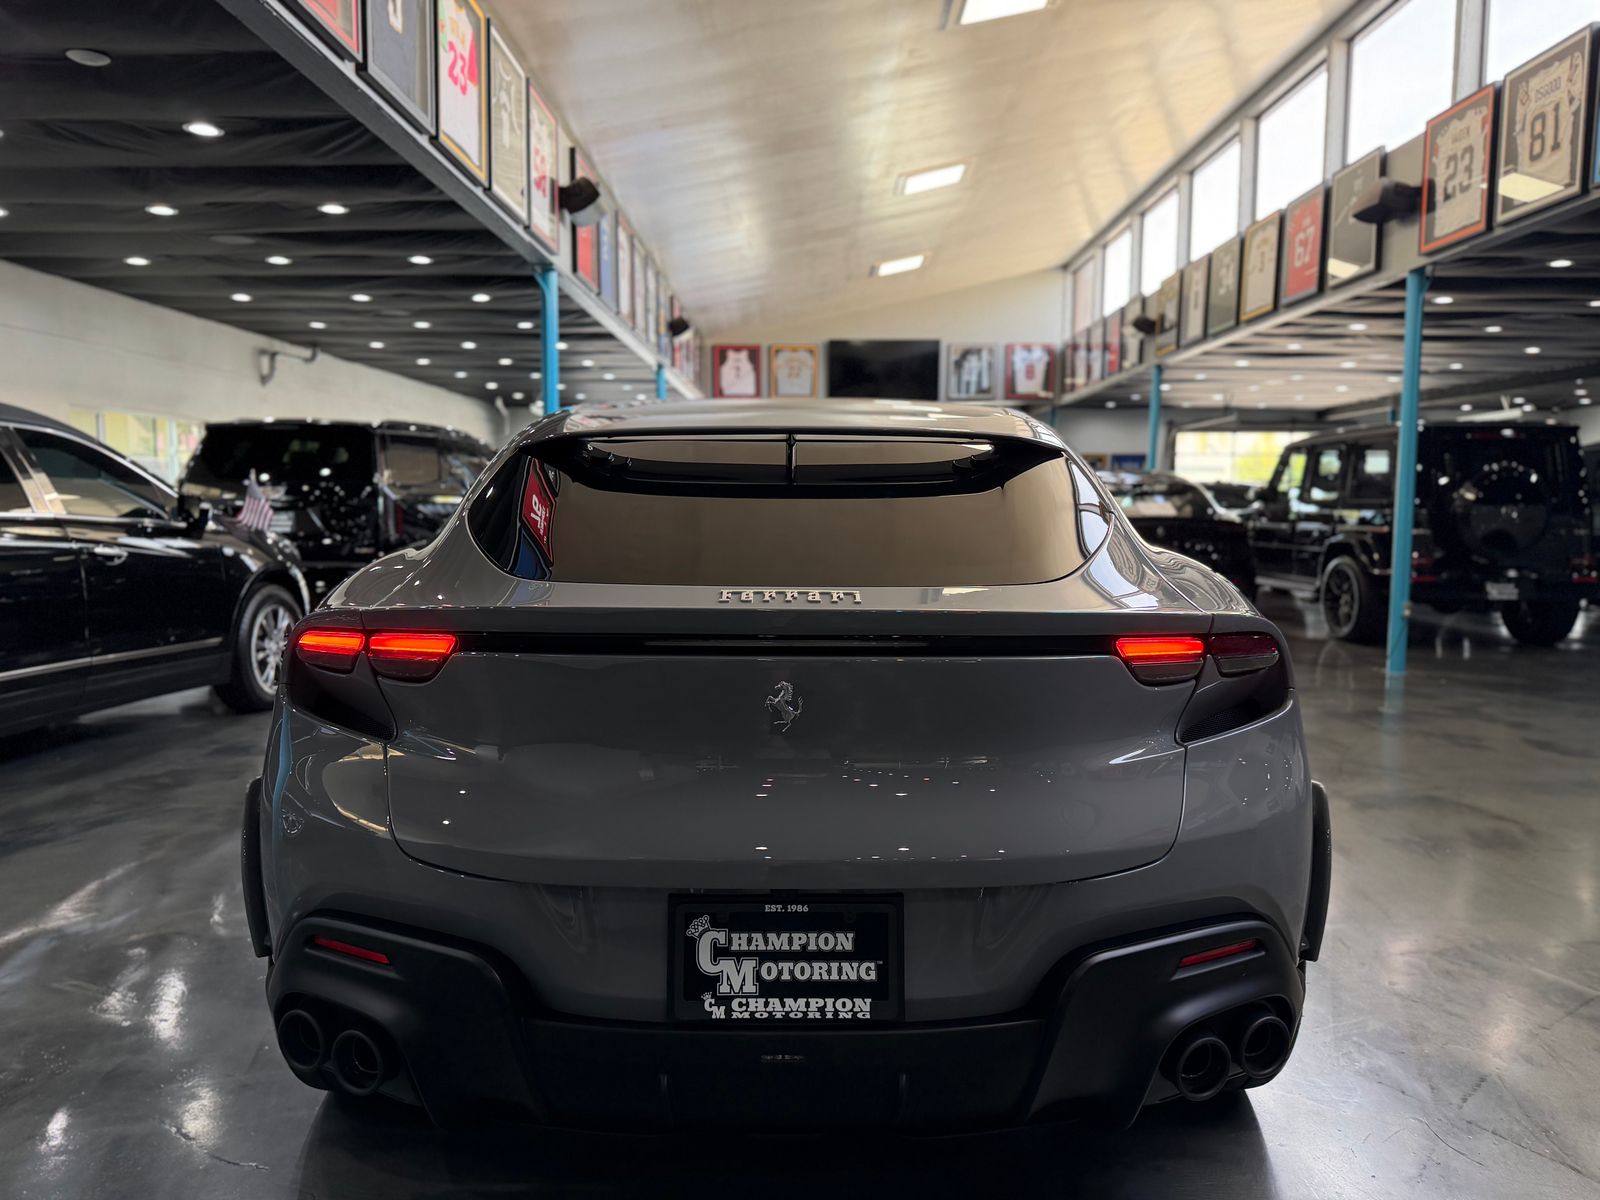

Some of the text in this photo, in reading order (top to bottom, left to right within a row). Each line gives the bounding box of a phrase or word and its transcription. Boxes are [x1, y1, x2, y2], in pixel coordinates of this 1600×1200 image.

[448, 40, 467, 96] 23
[1529, 102, 1561, 162] 81
[1443, 144, 1474, 203] 23
[718, 588, 862, 604] Ferrari
[764, 904, 809, 913] EST. 1986
[696, 929, 855, 976] CHAMPION
[717, 957, 877, 996] MOTORING
[703, 997, 872, 1020] CM CHAMPION
[731, 1011, 872, 1019] MOTORING
